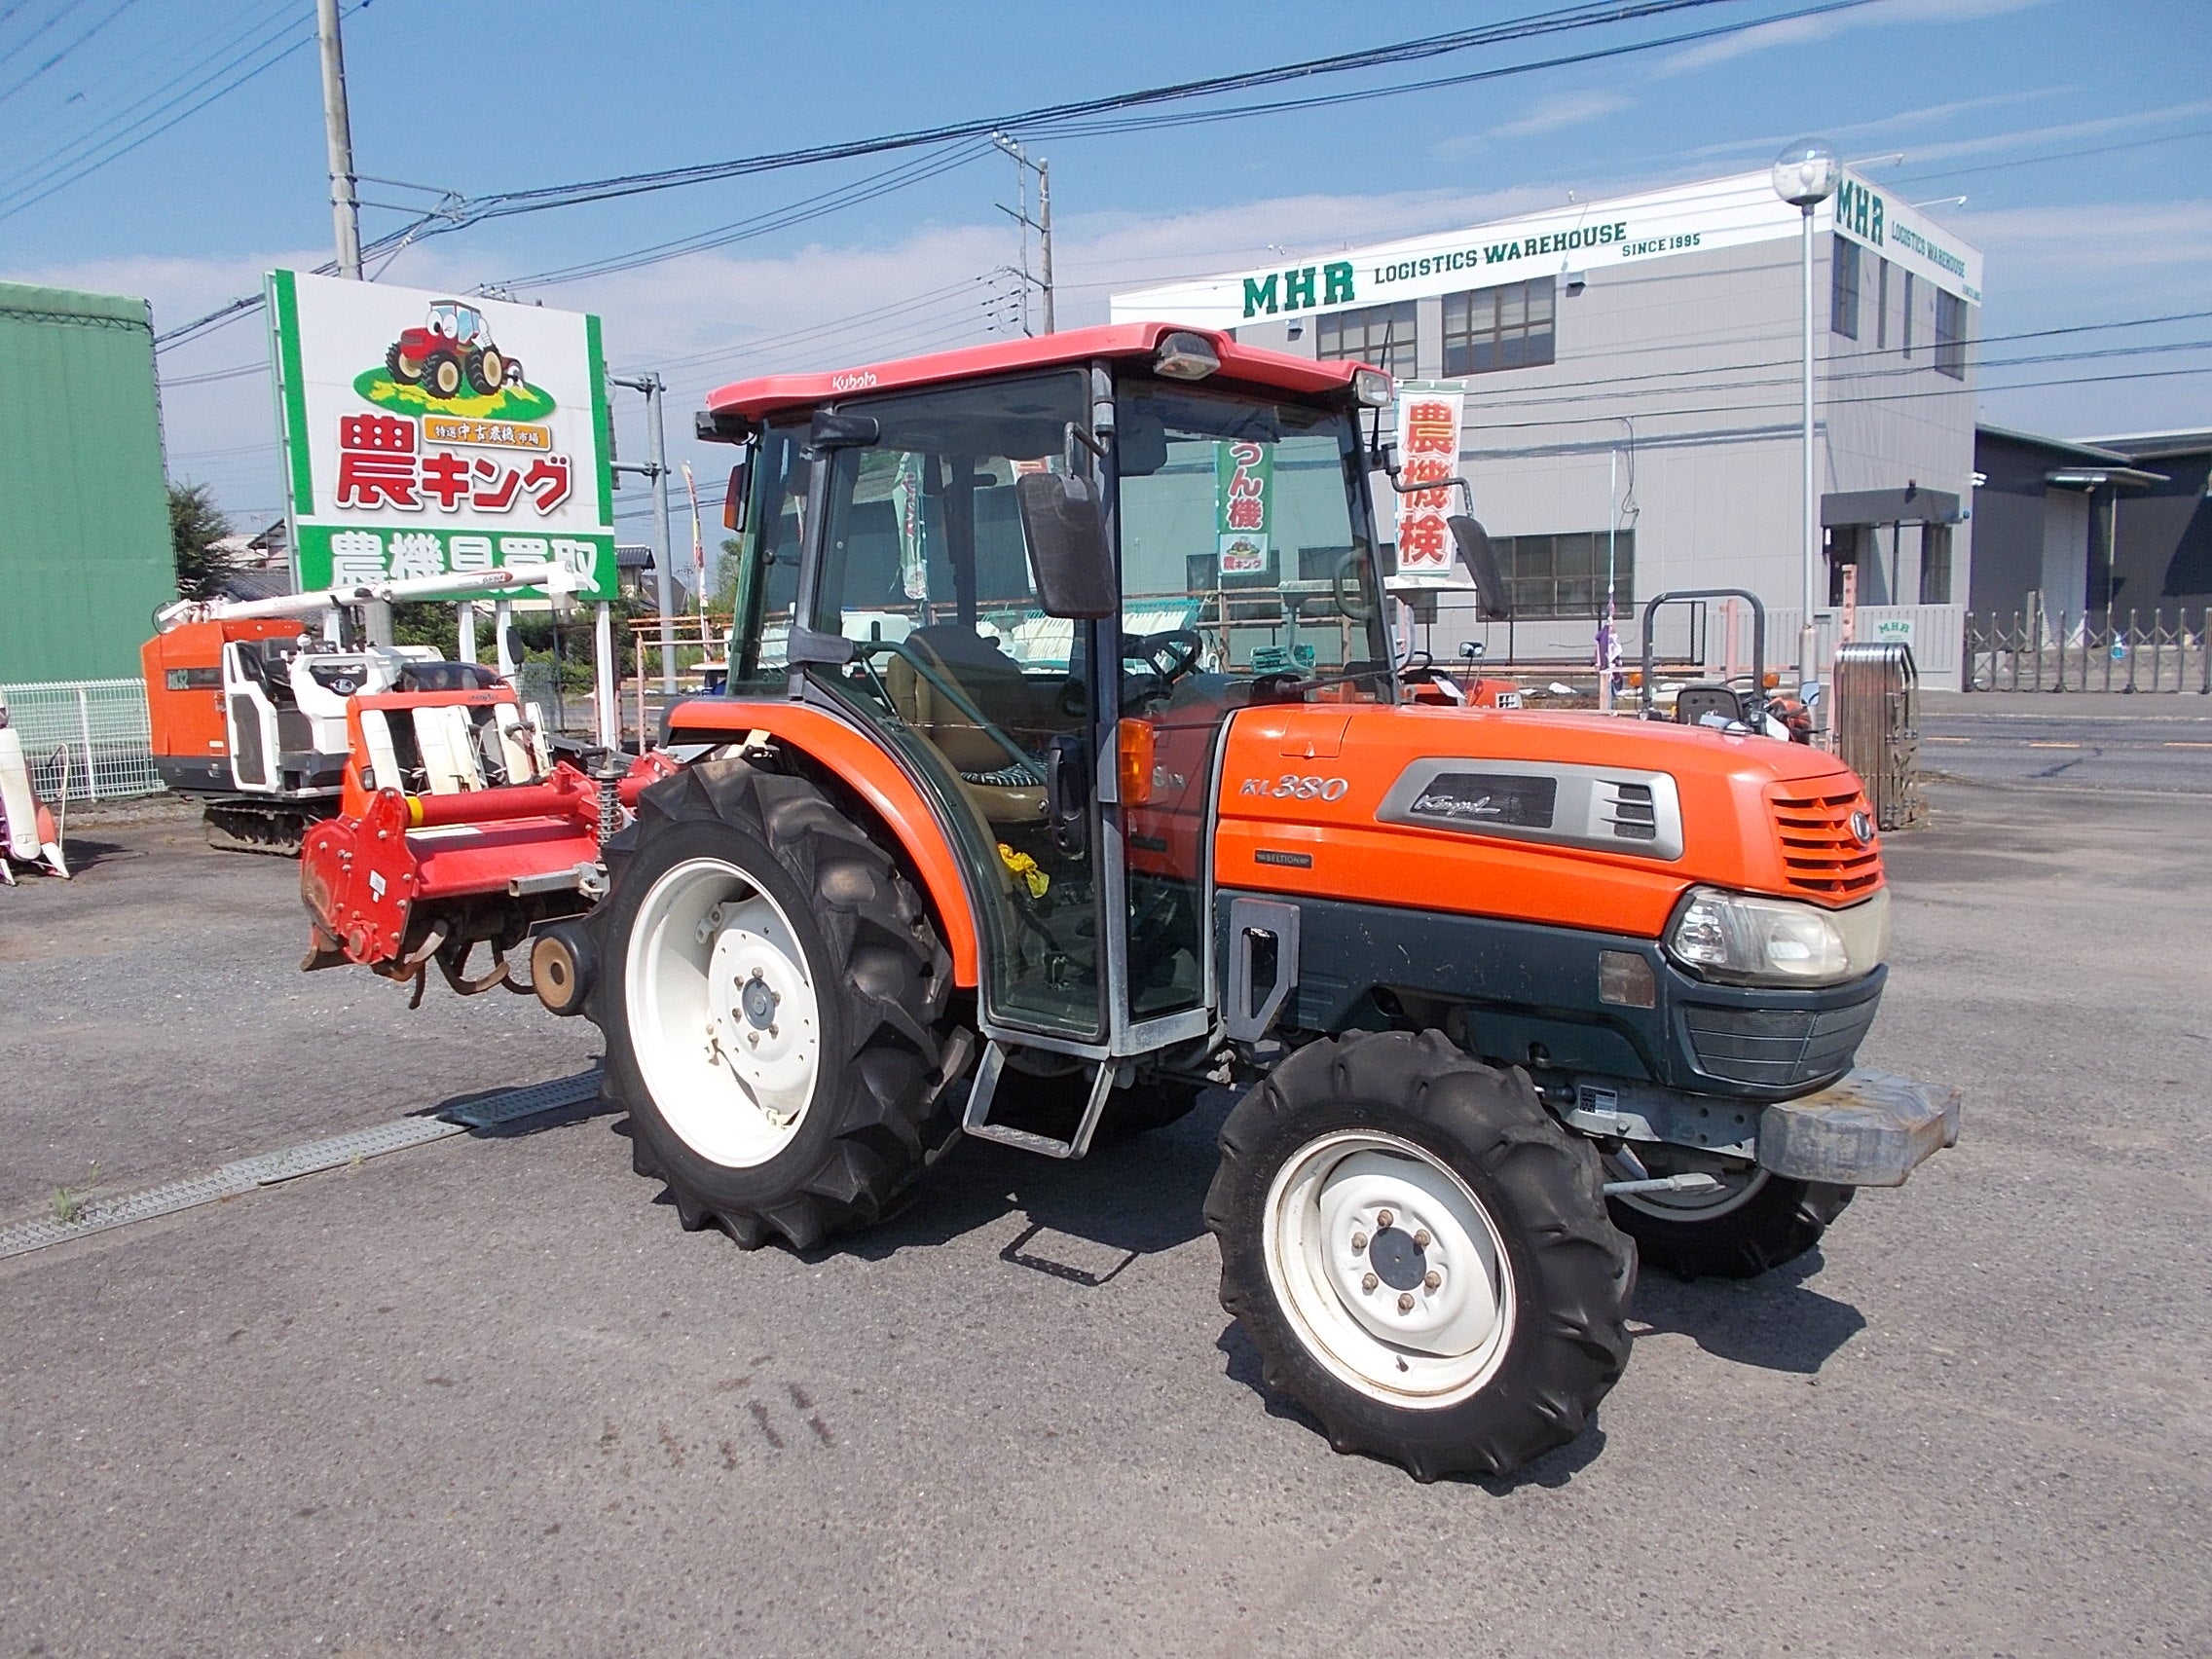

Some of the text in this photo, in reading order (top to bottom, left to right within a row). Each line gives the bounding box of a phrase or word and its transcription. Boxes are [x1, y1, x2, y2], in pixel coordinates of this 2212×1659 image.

[1836, 179, 1884, 247] MHR
[1374, 222, 1627, 285] LOGISTICS WAREHOUSE
[1622, 233, 1701, 257] SINCE 1995
[1242, 261, 1355, 318] MHR
[831, 371, 877, 390] Kubota
[336, 414, 570, 513] 農キング
[1266, 853, 1301, 865] BELTION
